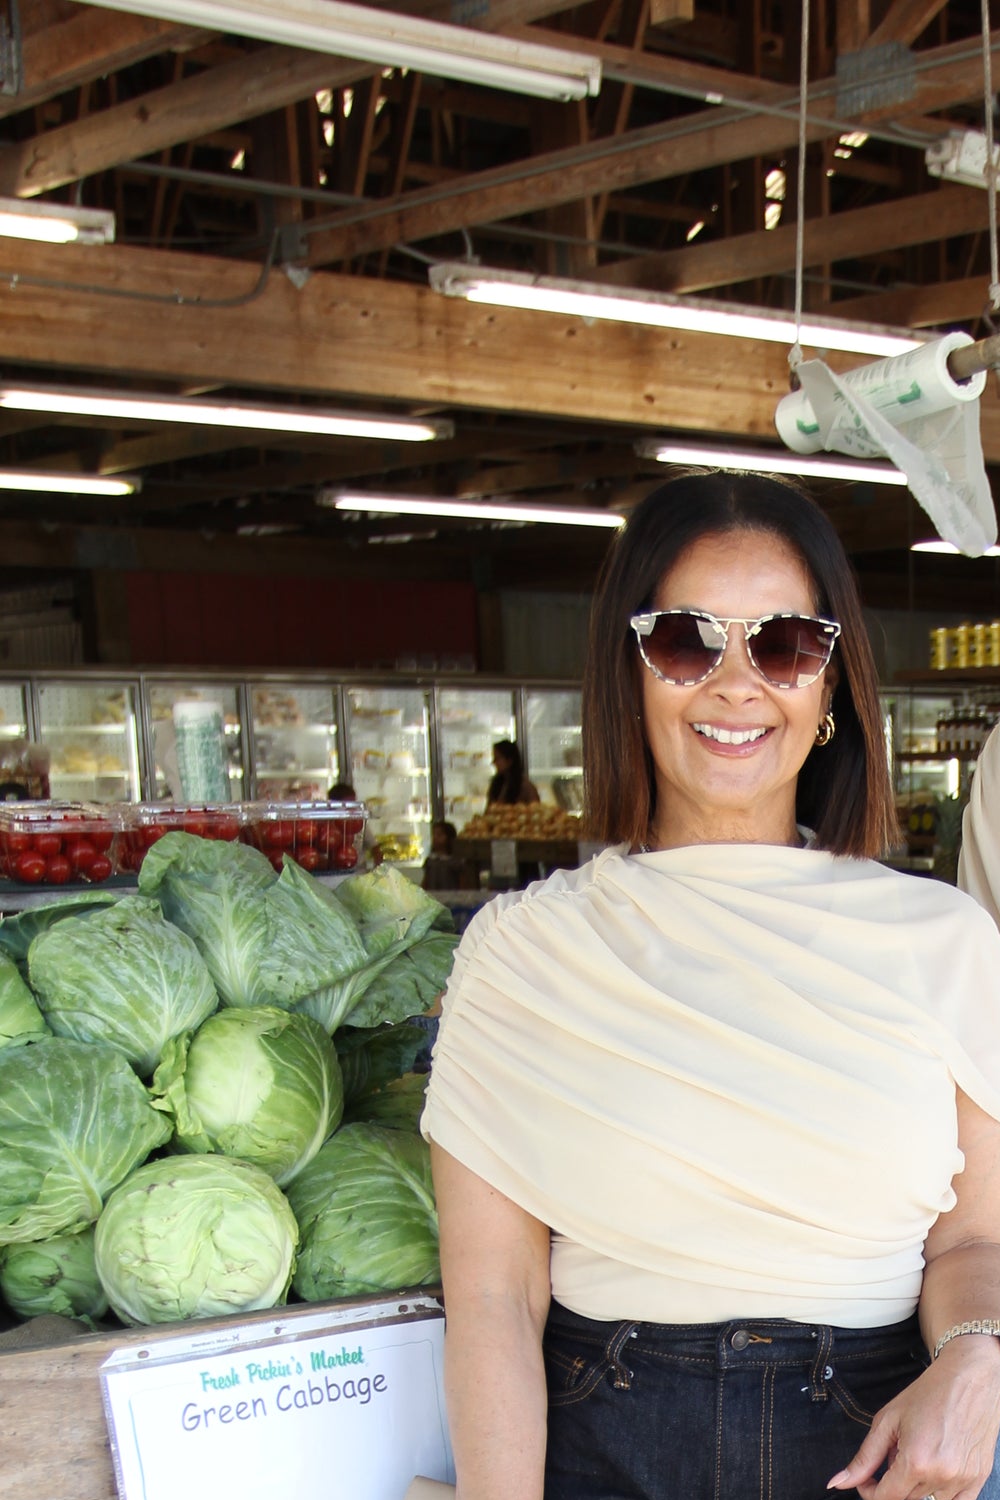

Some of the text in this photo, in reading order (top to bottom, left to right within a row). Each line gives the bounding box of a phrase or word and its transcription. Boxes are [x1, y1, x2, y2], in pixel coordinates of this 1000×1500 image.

[200, 1346, 364, 1392] Fresh Pickin's Market
[181, 1374, 388, 1431] Green Cabbage
